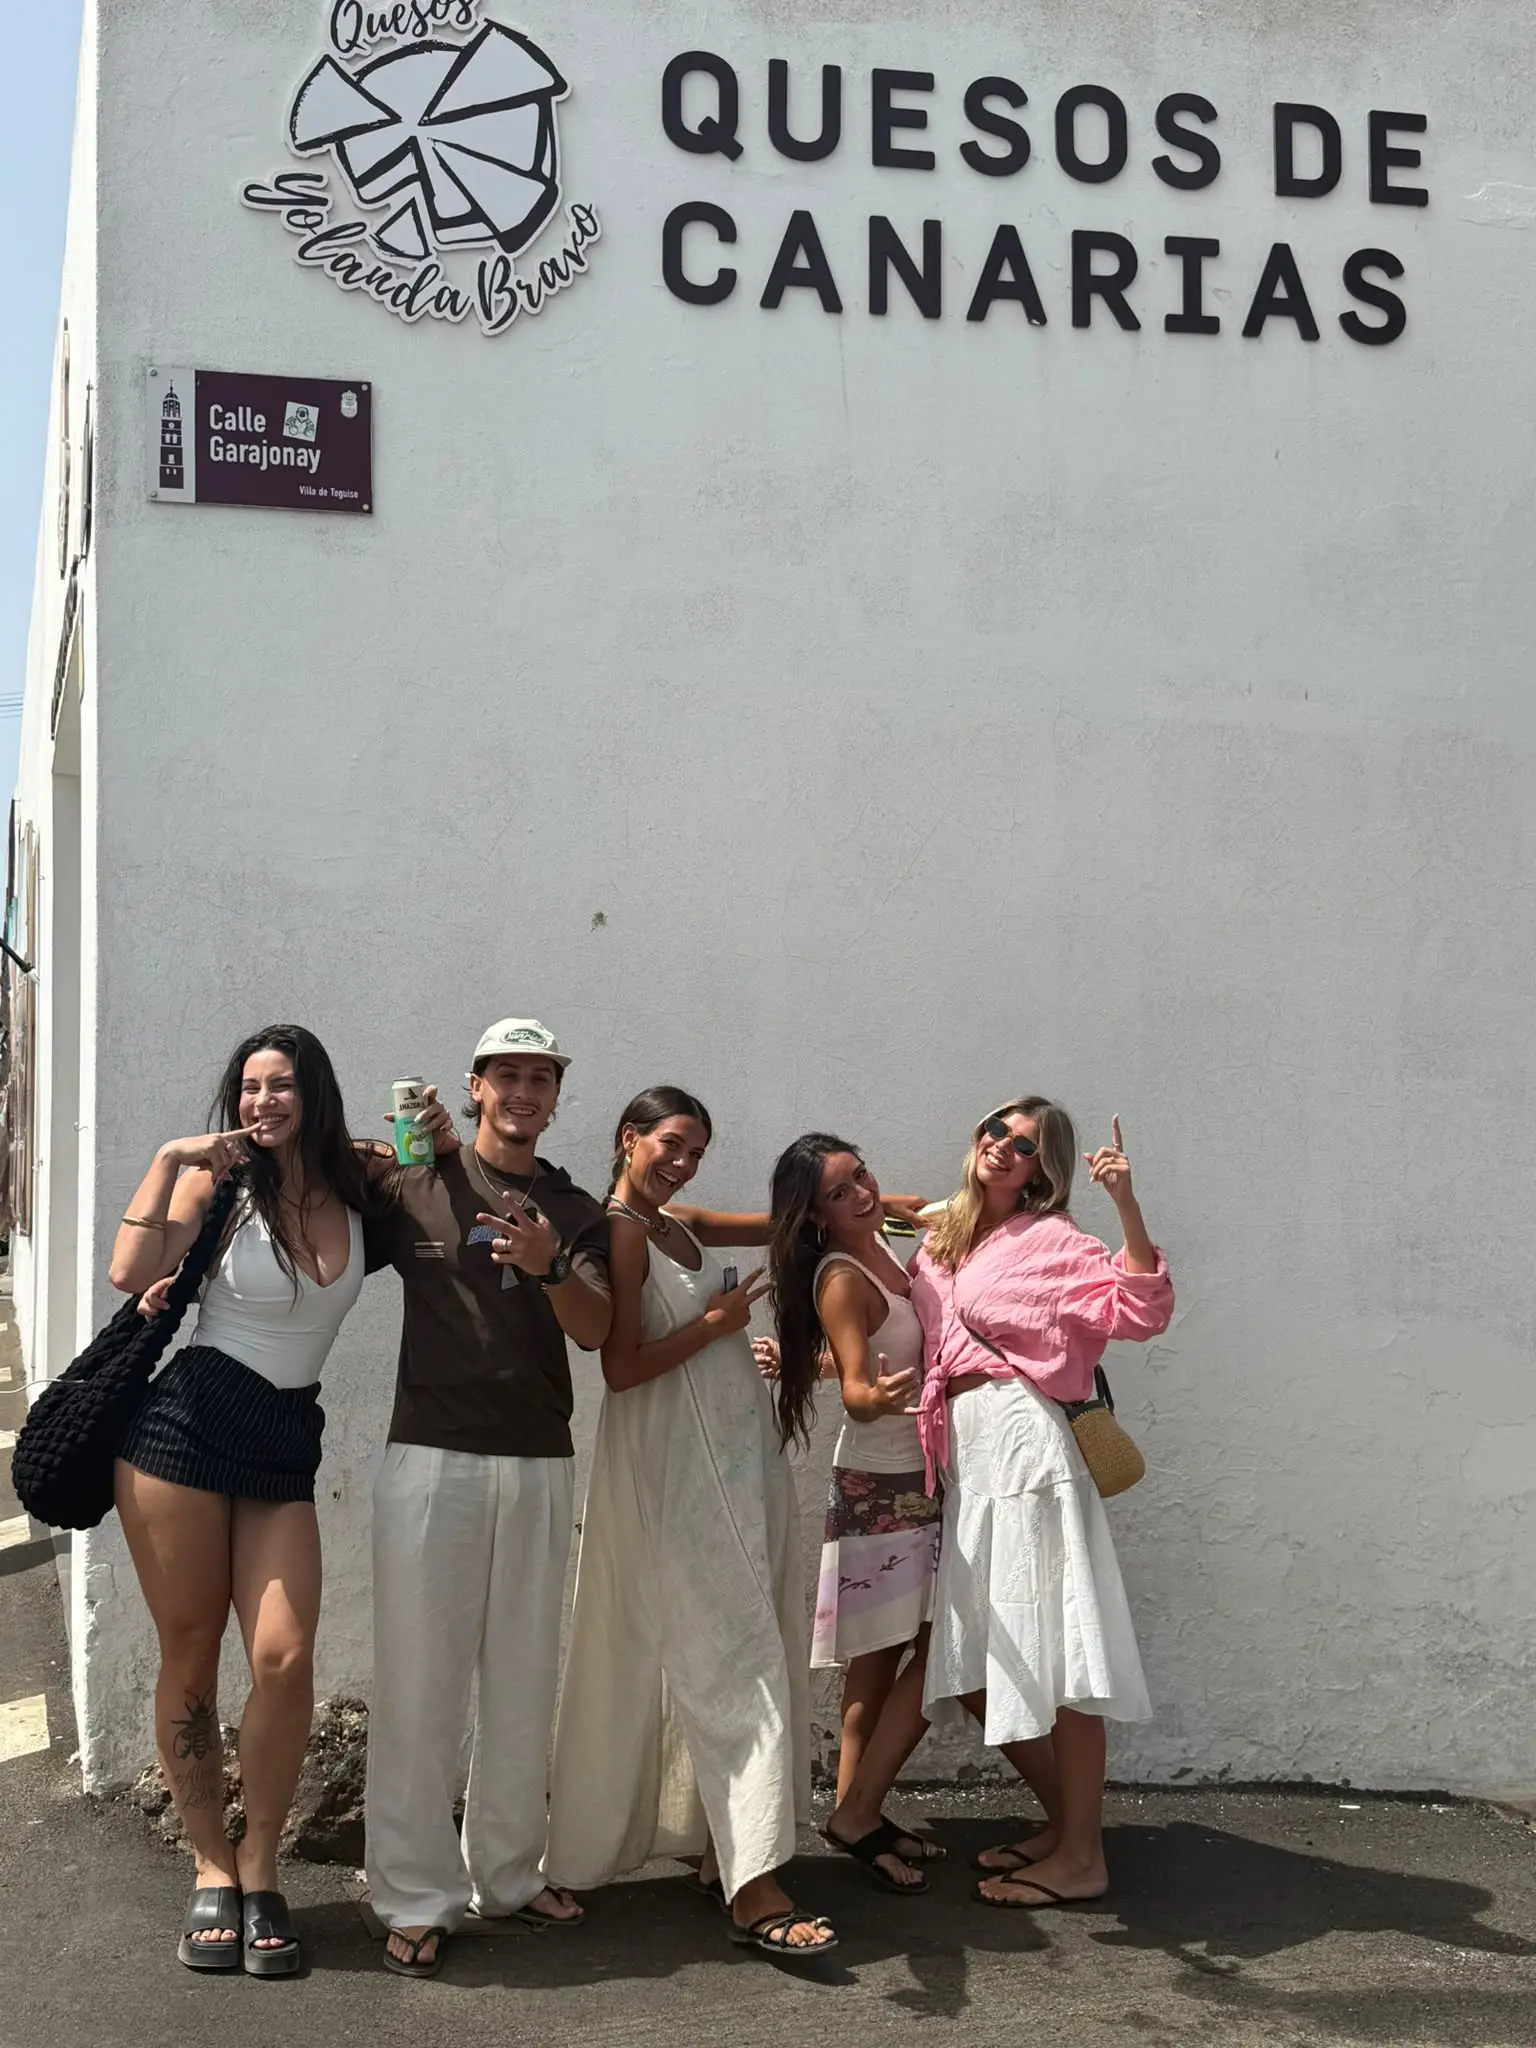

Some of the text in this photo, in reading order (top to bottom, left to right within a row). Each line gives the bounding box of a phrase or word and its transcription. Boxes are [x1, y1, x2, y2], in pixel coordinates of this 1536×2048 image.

[662, 50, 1429, 208] QUESOS DE
[244, 172, 598, 330] Yolanda Bravo
[662, 201, 1407, 346] CANARIAS
[209, 404, 266, 433] Calle
[209, 435, 321, 474] Garajonay
[299, 485, 359, 500] Villa de Teguise
